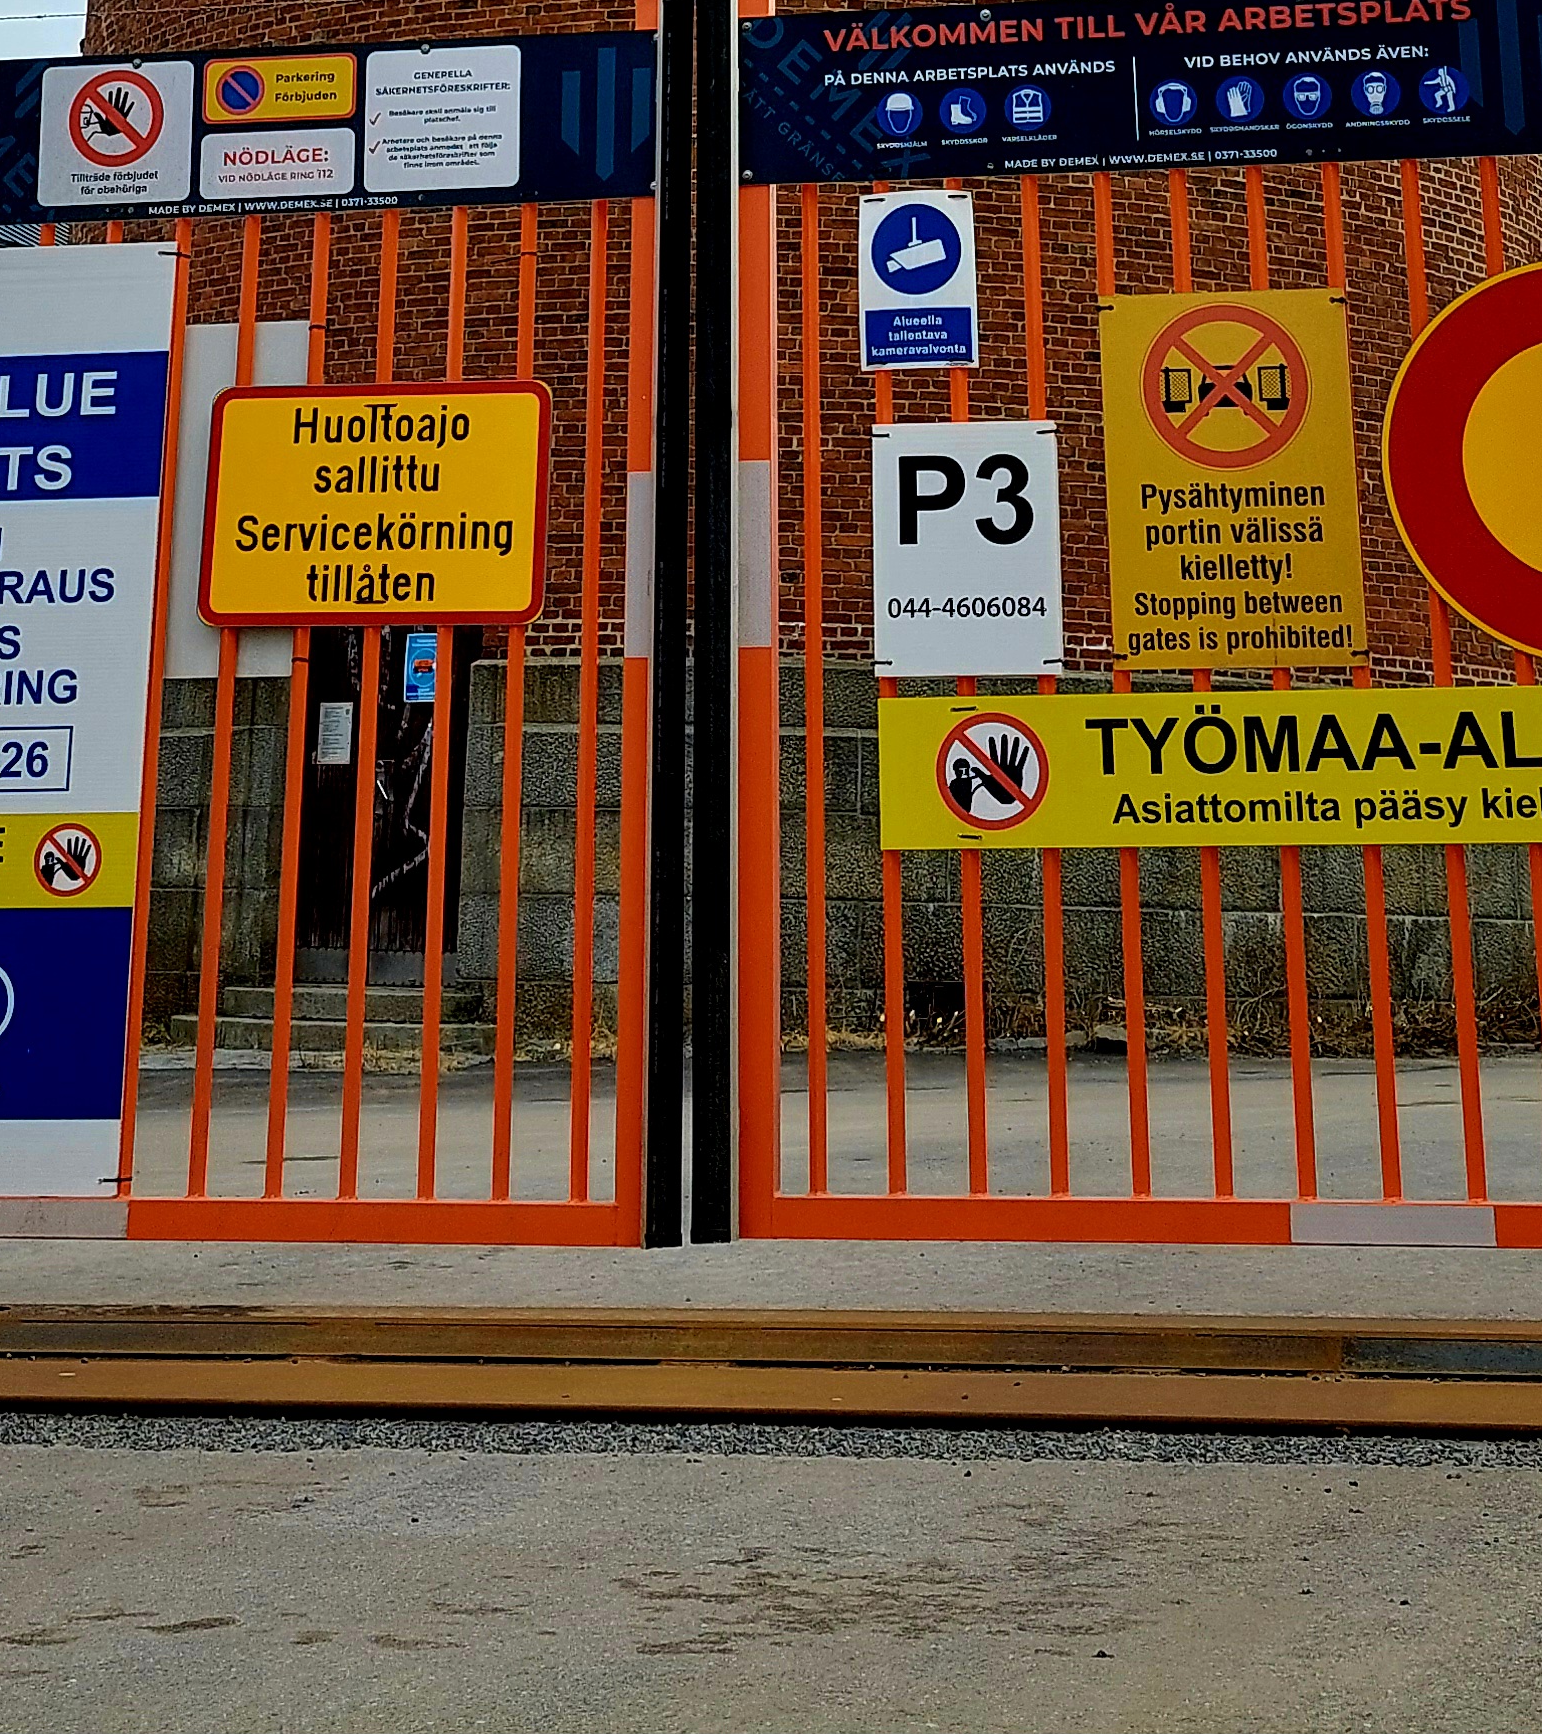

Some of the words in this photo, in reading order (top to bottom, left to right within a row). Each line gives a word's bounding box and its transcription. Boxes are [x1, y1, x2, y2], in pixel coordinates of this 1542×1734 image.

[823, 20, 1043, 52] VÄLKOMMEN
[1054, 14, 1125, 39] TILL
[1134, 3, 1206, 36] VÅR
[1183, 55, 1214, 68] VID
[1220, 51, 1280, 67] BEHOV
[1285, 47, 1371, 64] ANVÄNDS
[1376, 44, 1429, 60] ÄVEN:
[275, 71, 335, 84] Parkering
[824, 70, 846, 86] PÅ
[851, 70, 908, 85] DENNA
[913, 64, 1028, 83] ARBETSPLATS
[1032, 59, 1115, 76] ANVÄNDS
[274, 91, 337, 103] Förbjuden
[223, 145, 329, 166] NÖDLÄGE:
[1005, 158, 1038, 169] MADE
[1041, 158, 1056, 168] BY
[1059, 155, 1099, 167] DEMEX
[1109, 151, 1205, 165] WWW.DEMEX.SE
[1214, 149, 1277, 160] 0371-33500
[218, 175, 235, 183] VID
[238, 171, 287, 182] NÖDLÄGE
[290, 171, 314, 180] RING
[316, 169, 334, 179] 112
[149, 206, 179, 214] MADE
[182, 205, 196, 214] BY
[199, 203, 235, 213] DEMEX
[893, 314, 942, 327] Alueella
[871, 343, 967, 356] kameravalvonta
[293, 404, 470, 448] Huoltoajo
[313, 454, 440, 493] sallittu
[898, 453, 1034, 546] P3
[1141, 481, 1325, 515] Pysähtyminen
[235, 512, 514, 556] Servicekörning
[1145, 518, 1221, 551] portin
[1230, 516, 1324, 544] välissä
[306, 563, 435, 602] tillåten
[1180, 553, 1293, 585] kielletty!
[887, 596, 1047, 619] 044-4606084
[1134, 591, 1236, 620] Stopping
[1244, 590, 1343, 614] between
[1128, 628, 1190, 656] gates
[1198, 626, 1218, 650] is
[1226, 623, 1353, 655] prohibited!
[1112, 790, 1340, 825] Asiattomilta
[1354, 790, 1469, 828] pääsy
